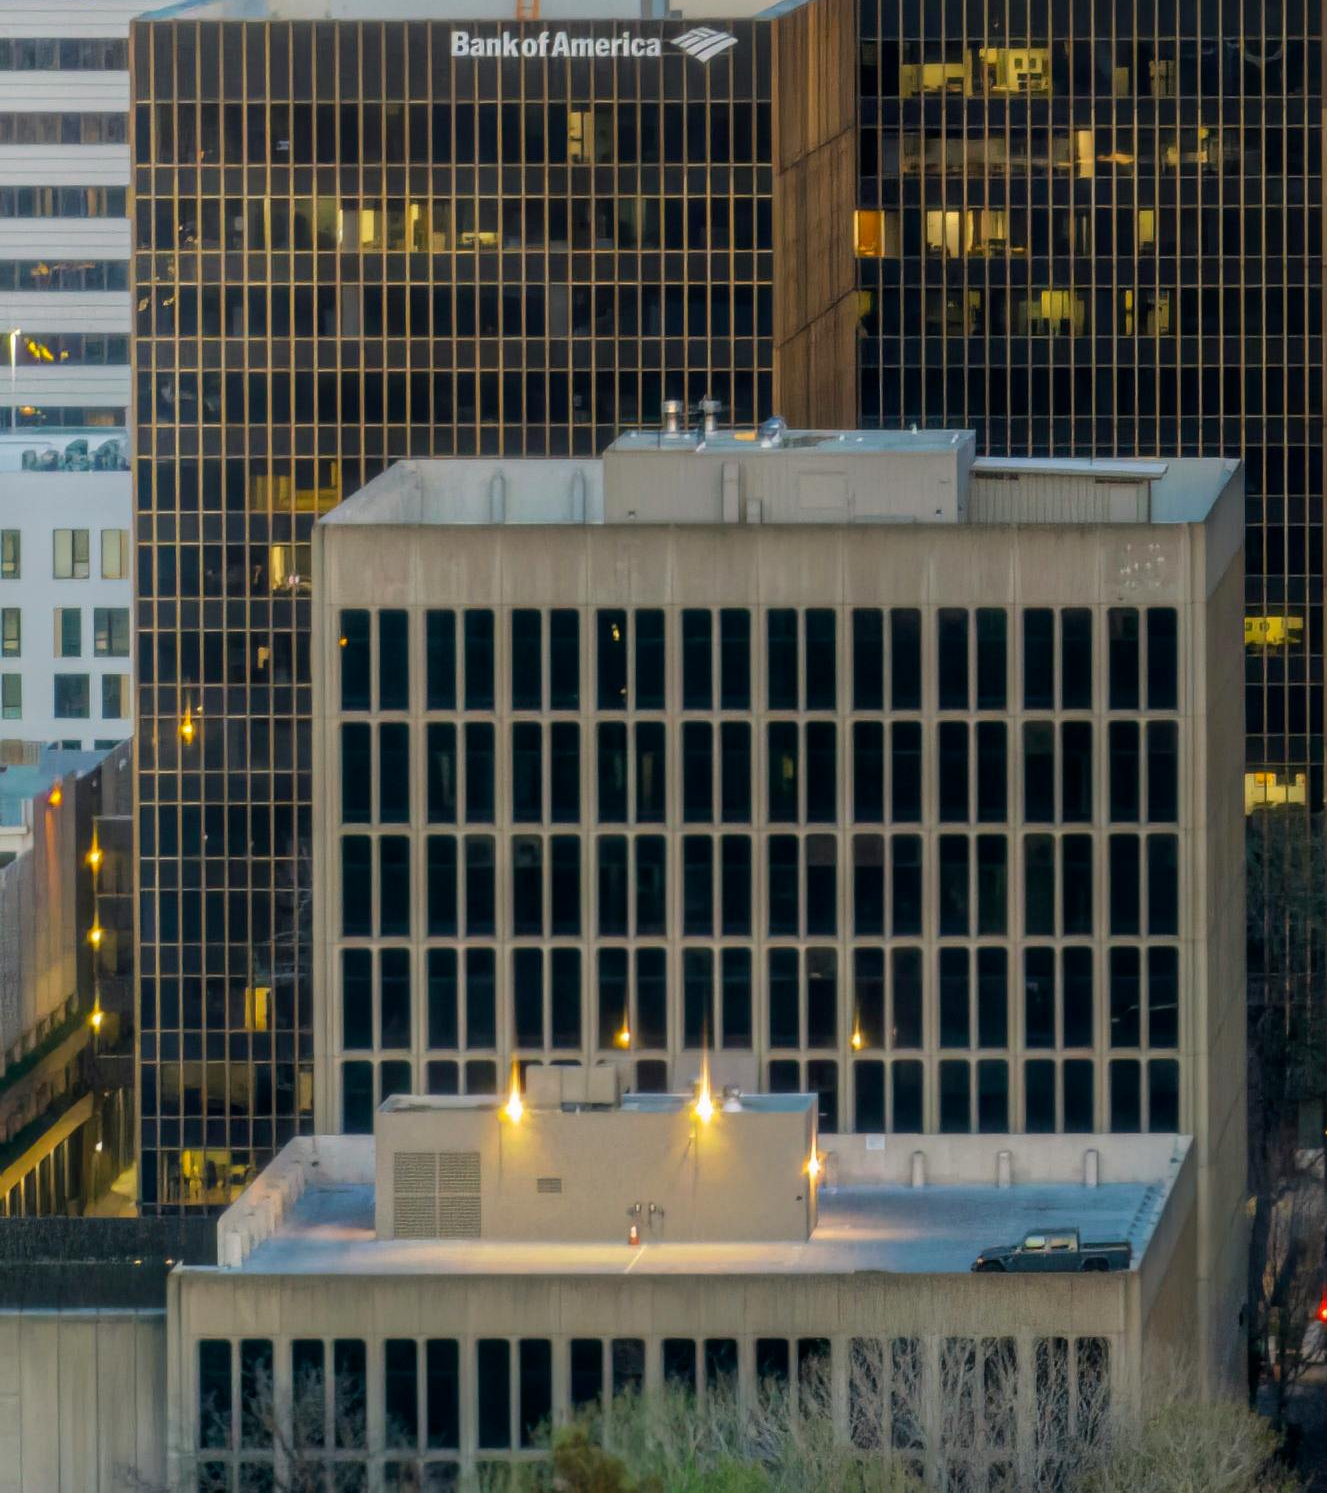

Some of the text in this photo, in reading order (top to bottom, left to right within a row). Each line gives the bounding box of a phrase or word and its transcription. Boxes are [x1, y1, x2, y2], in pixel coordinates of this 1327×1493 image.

[451, 31, 661, 57] Bank of America
